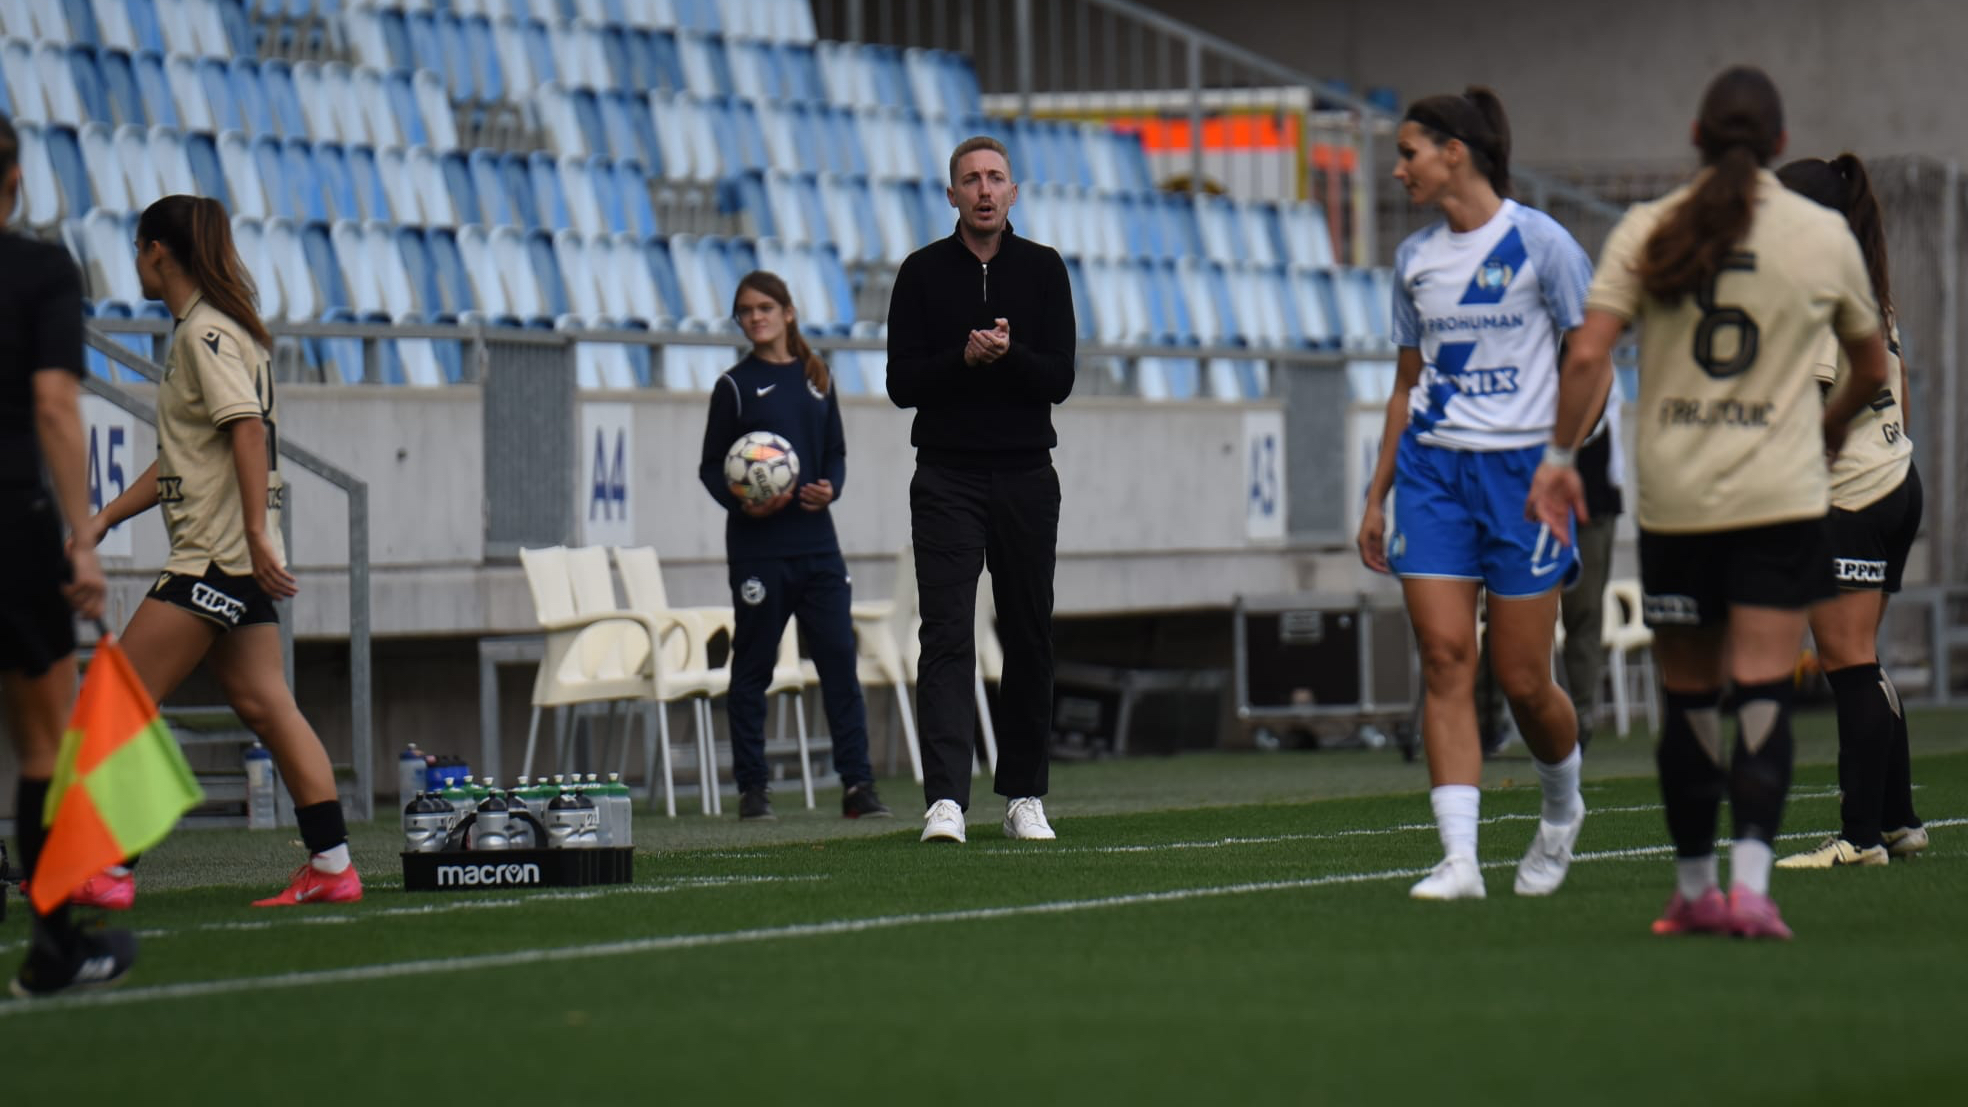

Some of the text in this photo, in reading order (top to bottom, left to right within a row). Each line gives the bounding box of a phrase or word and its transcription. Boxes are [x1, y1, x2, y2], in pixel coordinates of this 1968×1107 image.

[1427, 314, 1525, 332] PROHUMAN
[1693, 250, 1761, 381] 6
[88, 422, 126, 532] A5
[588, 424, 628, 521] A4
[1248, 433, 1278, 517] A3
[437, 863, 541, 887] macron
